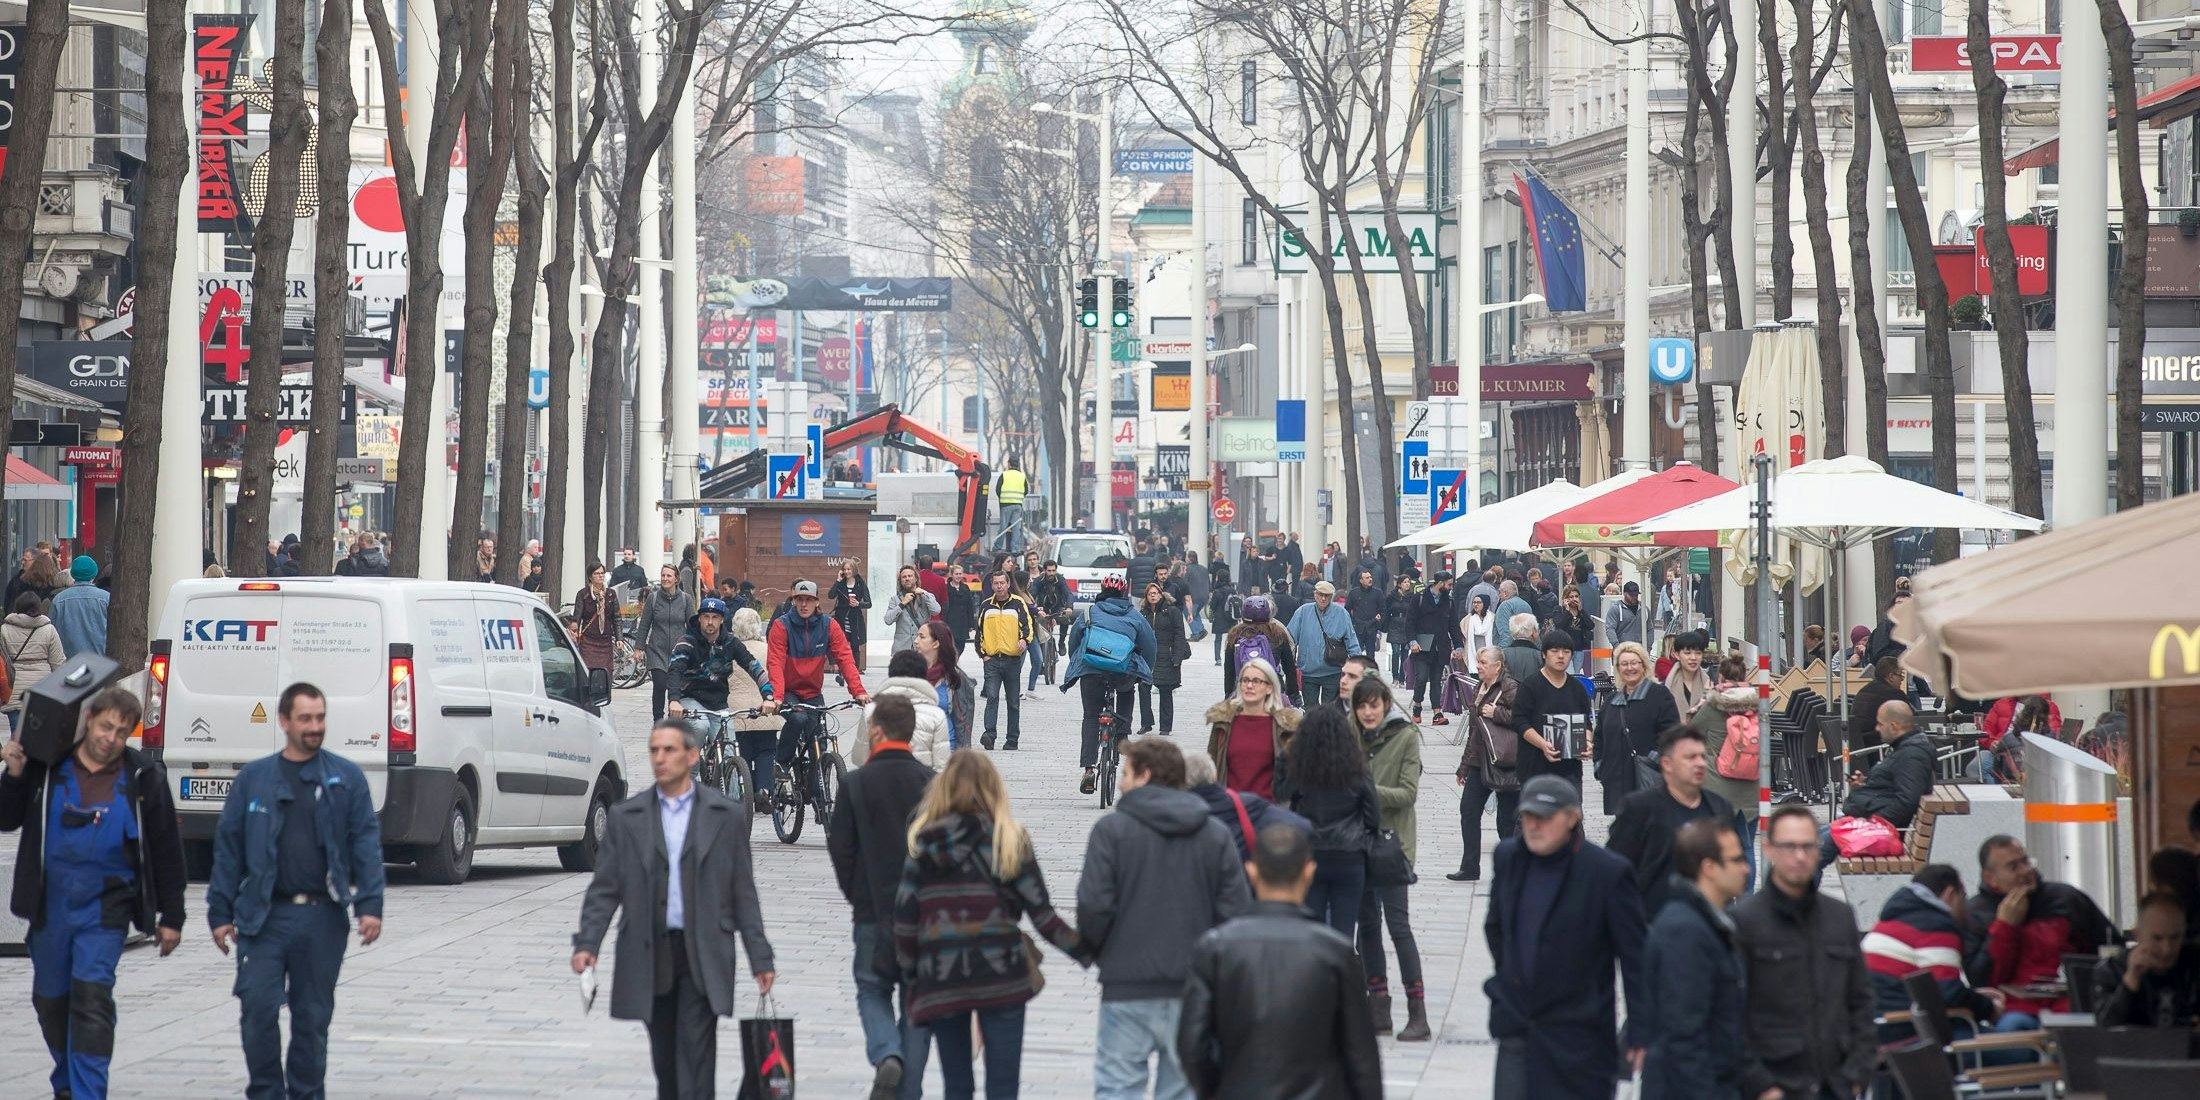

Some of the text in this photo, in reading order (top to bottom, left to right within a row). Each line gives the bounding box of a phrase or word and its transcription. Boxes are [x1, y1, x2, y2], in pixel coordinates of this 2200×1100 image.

[1957, 42, 2061, 66] SPA
[1283, 227, 1435, 258] SAMA
[199, 278, 309, 299] SOLINER
[864, 297, 939, 306] Haus des Meeres
[1657, 346, 1686, 378] U
[69, 379, 108, 388] GRAIN
[1434, 379, 1566, 393] HOL KUMMER
[69, 450, 112, 461] AUTOMAT
[1159, 453, 1190, 473] KIN
[1077, 592, 1098, 600] POLI
[183, 619, 278, 642] KAT
[480, 618, 525, 651] KAT
[191, 781, 209, 795] RH
